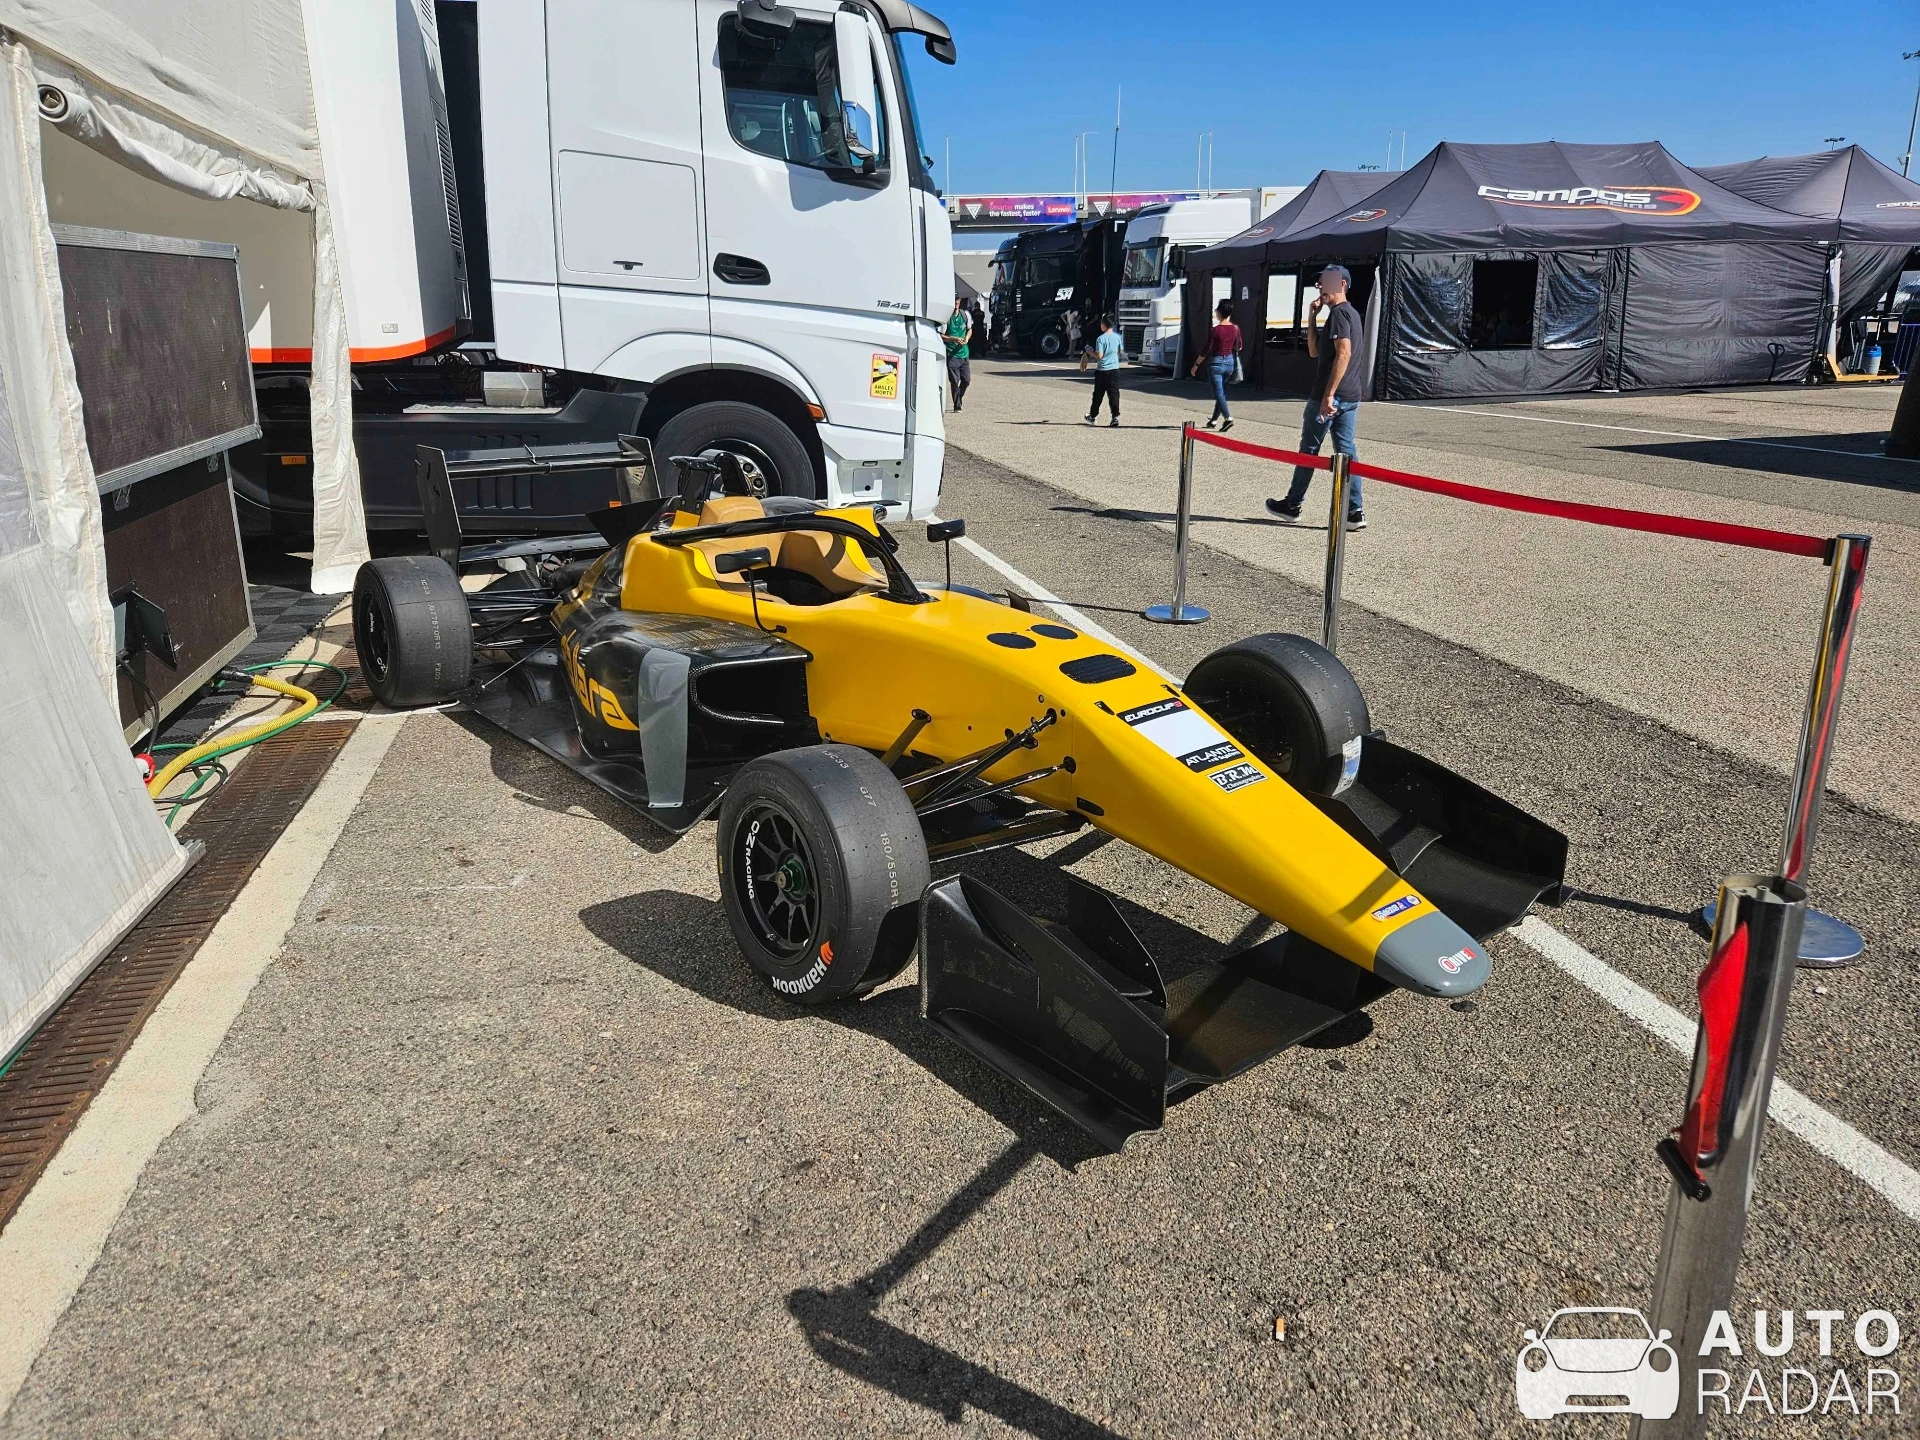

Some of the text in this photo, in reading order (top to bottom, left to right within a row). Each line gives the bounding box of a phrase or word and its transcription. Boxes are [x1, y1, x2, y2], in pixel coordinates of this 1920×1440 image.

[1047, 206, 1070, 214] Lenovo
[1185, 744, 1238, 766] ATLANTIC
[745, 847, 755, 899] RACING
